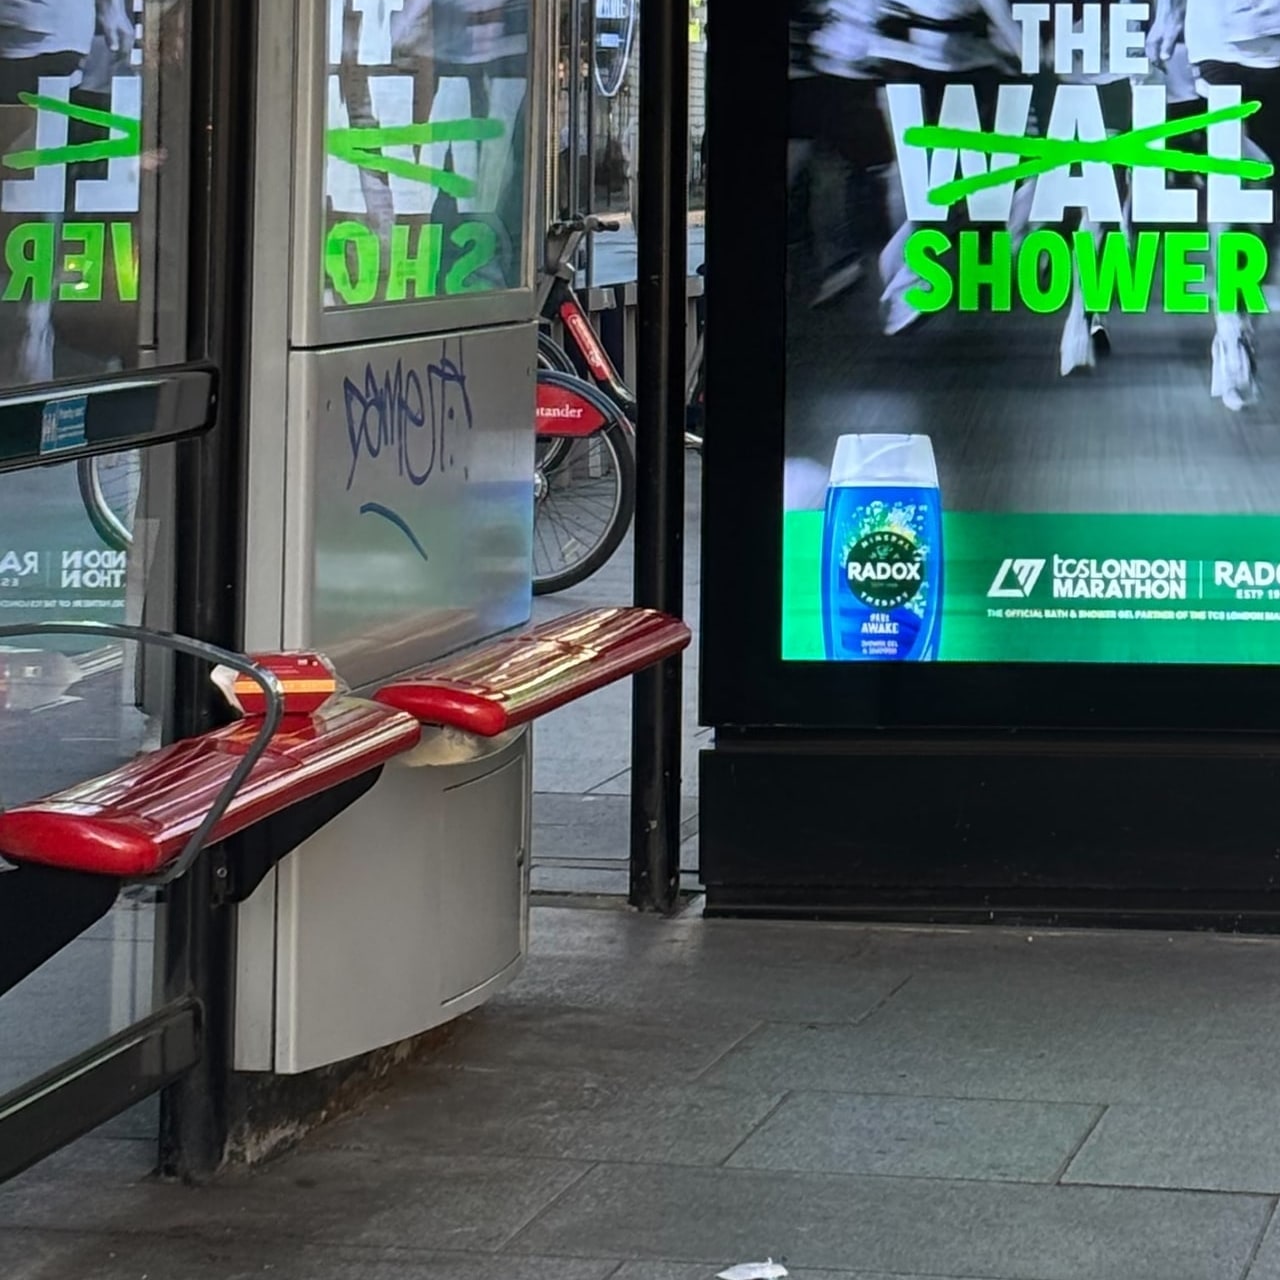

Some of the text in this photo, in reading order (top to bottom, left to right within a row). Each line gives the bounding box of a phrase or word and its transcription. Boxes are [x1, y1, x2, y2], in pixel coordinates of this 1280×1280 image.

[1011, 3, 1150, 75] THE
[885, 84, 1275, 223] WALL
[903, 230, 1269, 314] SHOWER
[536, 403, 583, 419] tander
[847, 561, 921, 582] RADOX
[1053, 579, 1187, 599] MARATHON
[1005, 609, 1043, 618] OFFICIAL
[861, 622, 900, 634] AWAKE
